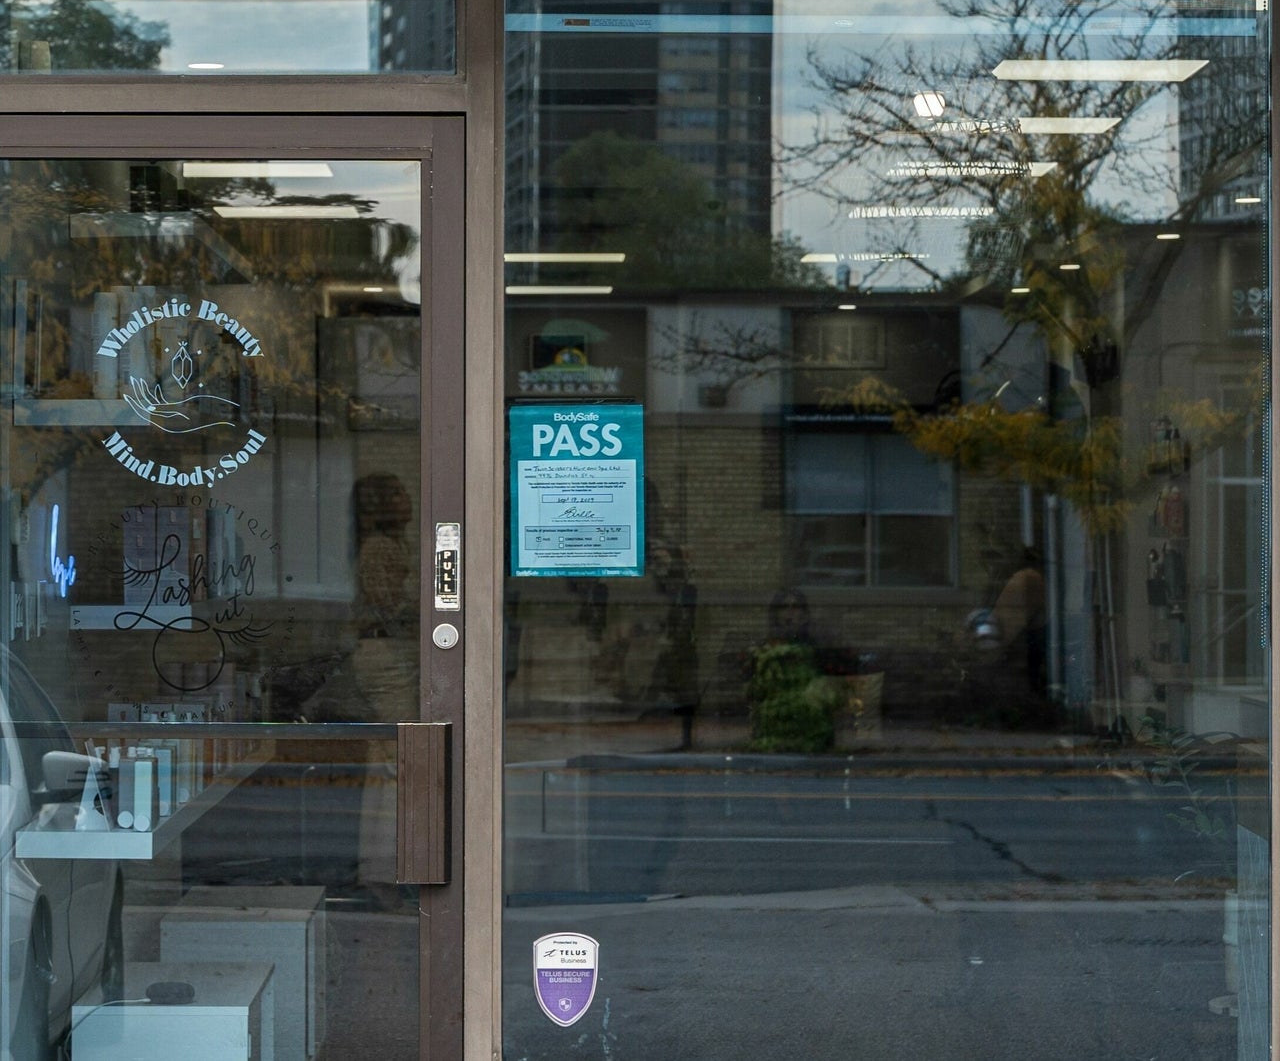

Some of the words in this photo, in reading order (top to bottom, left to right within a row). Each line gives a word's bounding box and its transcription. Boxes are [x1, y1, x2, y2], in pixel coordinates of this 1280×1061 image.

[97, 298, 191, 358] Wholistic
[197, 299, 265, 357] Beauty
[532, 423, 623, 457] PASS
[553, 412, 600, 423] BodySafe
[176, 495, 281, 556] BOUTIQUE
[113, 534, 256, 631] Lashing
[443, 551, 452, 592] PULL
